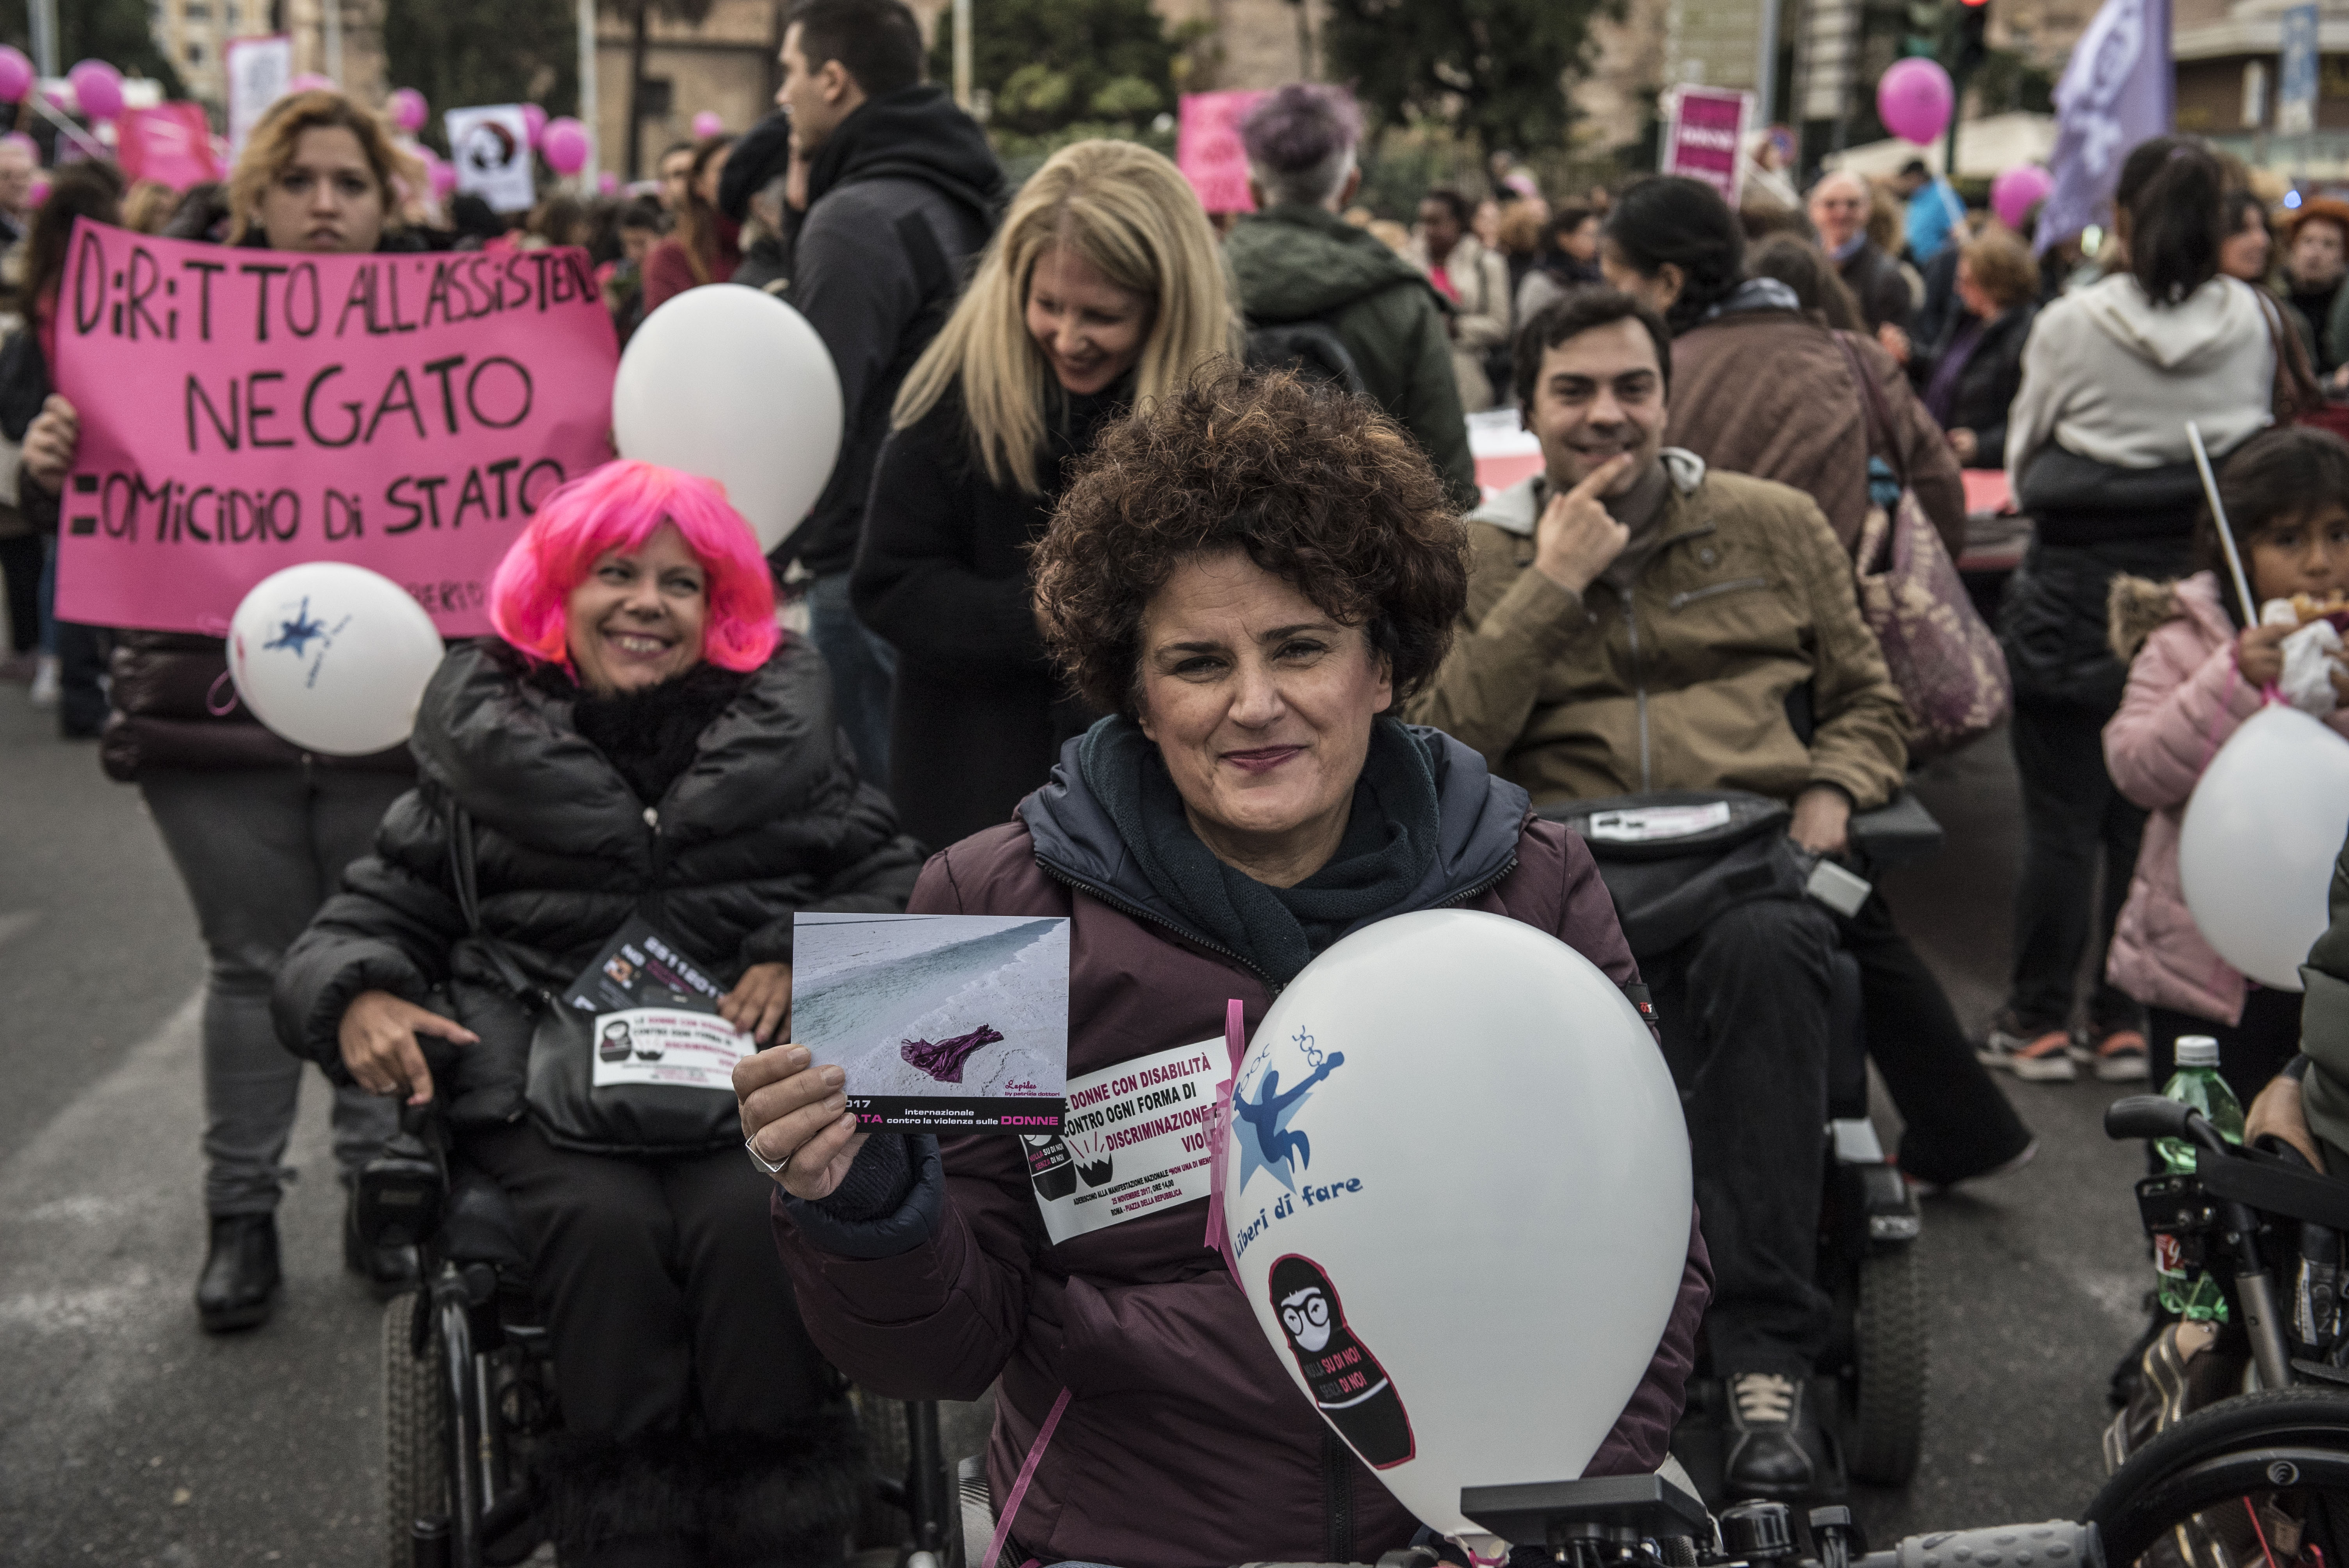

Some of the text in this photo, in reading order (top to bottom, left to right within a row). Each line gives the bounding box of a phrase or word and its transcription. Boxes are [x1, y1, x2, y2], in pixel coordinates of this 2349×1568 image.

[184, 355, 534, 454] NEGATO
[384, 457, 566, 535] STATO
[1070, 1083, 1110, 1110] DONNE
[1112, 1074, 1138, 1096] CON
[1139, 1052, 1212, 1088] DISABILITÀ
[1106, 1100, 1136, 1123] OGNI
[1137, 1087, 1181, 1114] FORMA
[1182, 1082, 1196, 1099] DI
[1001, 1116, 1059, 1125] DONNE
[1029, 1151, 1044, 1163] NULLA
[1055, 1143, 1064, 1151] NOI
[1035, 1158, 1051, 1171] SENZA
[1050, 1156, 1057, 1164] DI
[1073, 1194, 1097, 1206] ADERISCONO
[1098, 1188, 1109, 1198] ALLA
[1108, 1176, 1144, 1195] MANIFESTAZIONE
[1144, 1169, 1169, 1184] NAZIONALE
[1181, 1163, 1193, 1172] UNA
[1117, 1189, 1140, 1203] NOVEMBRE
[1152, 1183, 1162, 1192] ORE
[1162, 1179, 1174, 1189] 14,00
[1110, 1206, 1124, 1216] ROMA
[1125, 1201, 1141, 1212] PIAZZA
[1140, 1197, 1155, 1207] DELLA
[1155, 1188, 1182, 1203] REPUBBLICA
[1235, 1178, 1363, 1260] Liberi di fare
[1321, 1356, 1336, 1374] SU
[1332, 1353, 1346, 1369] DI
[1342, 1345, 1362, 1366] NOI
[1338, 1377, 1352, 1393] DI
[1347, 1371, 1367, 1390] NOI
